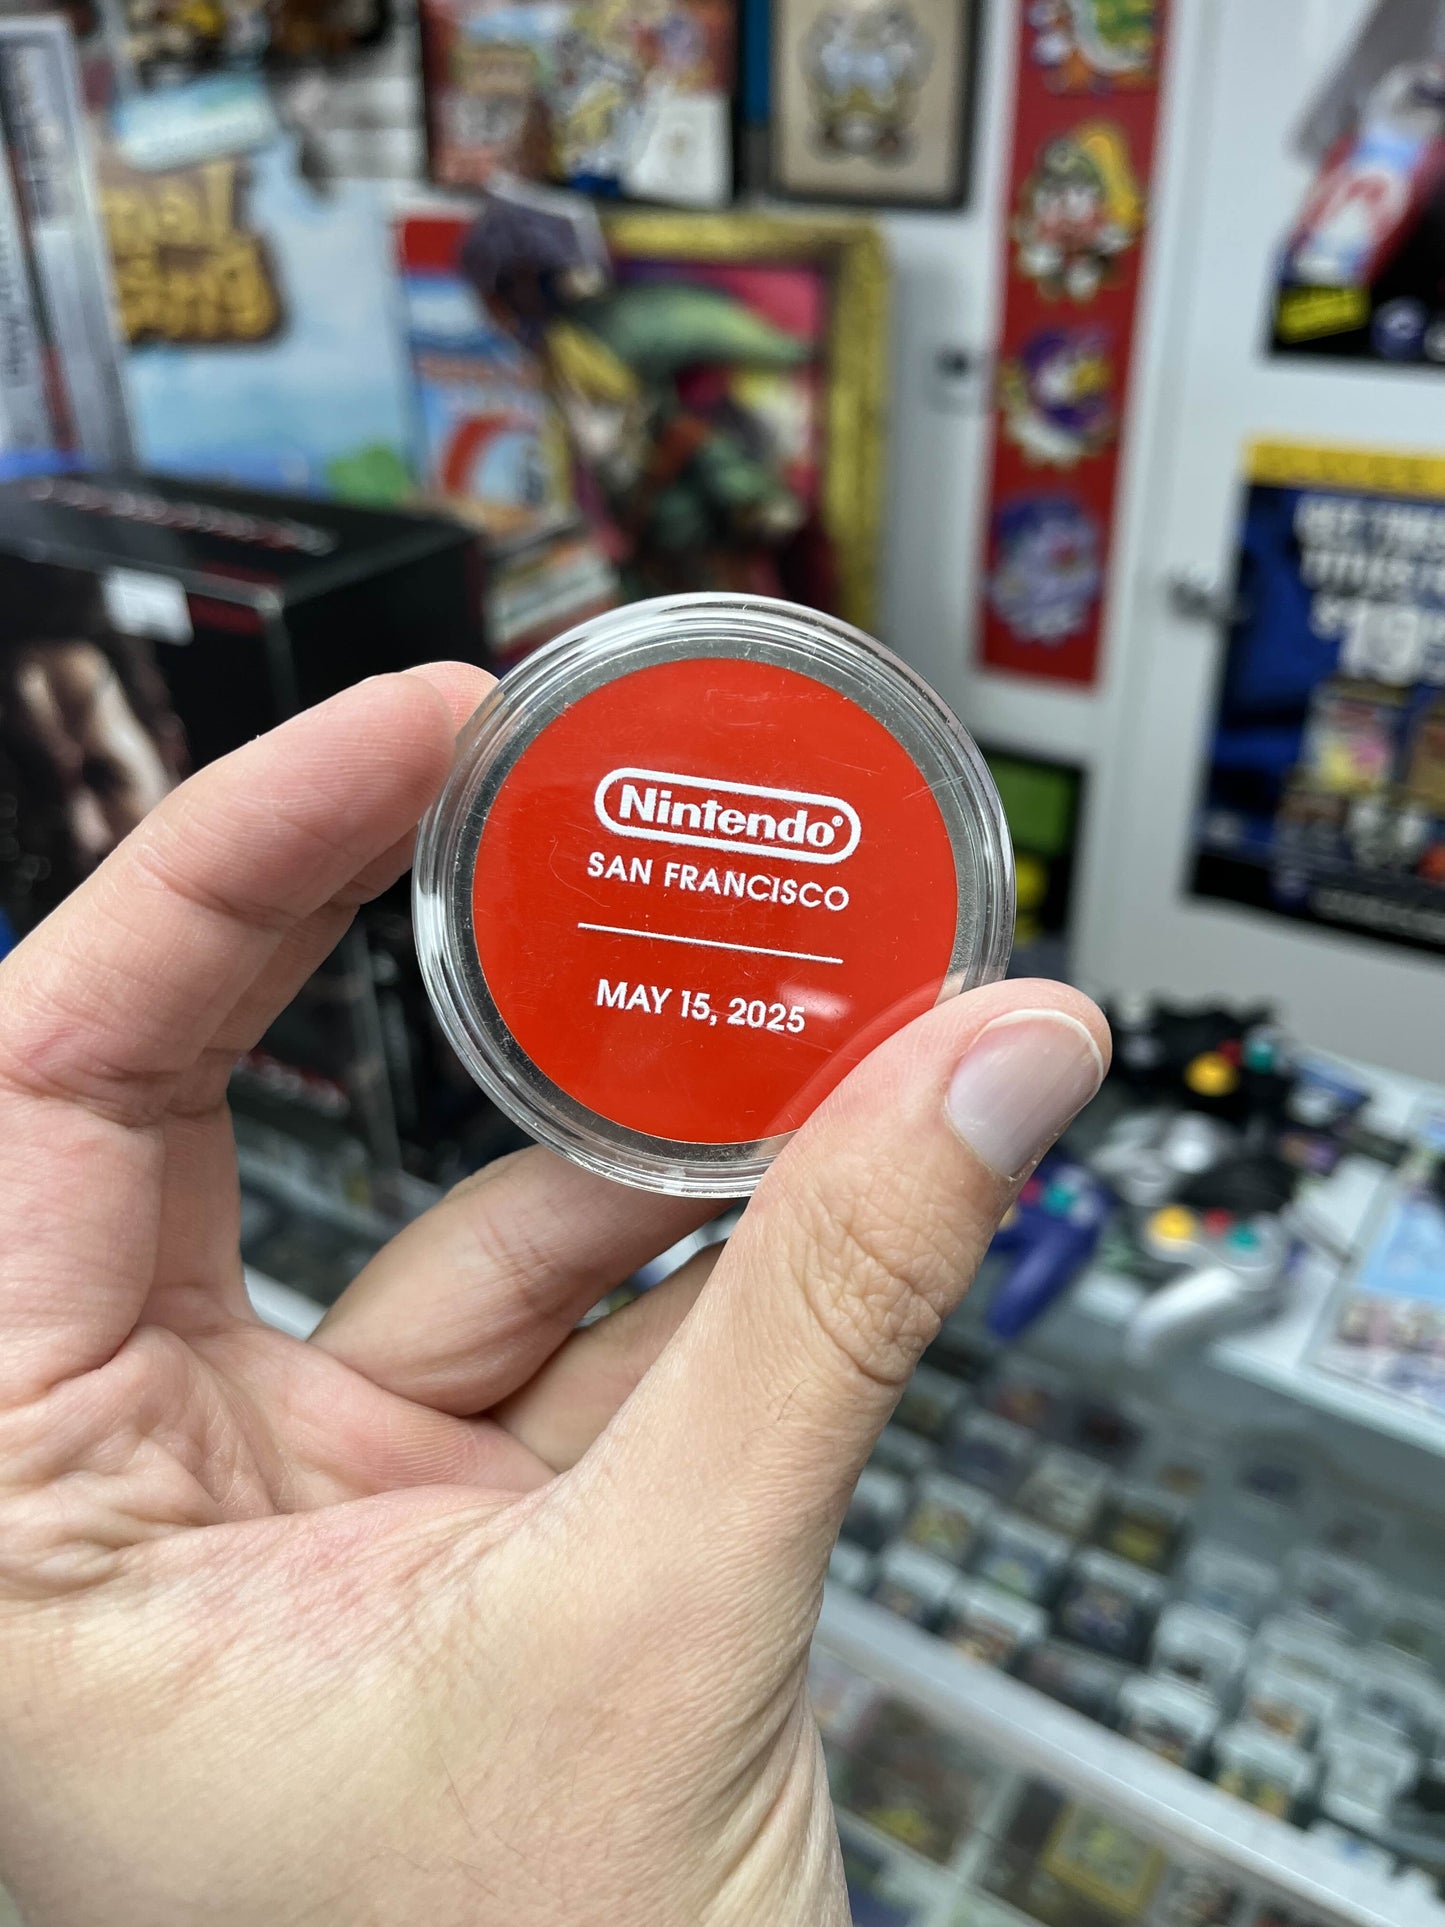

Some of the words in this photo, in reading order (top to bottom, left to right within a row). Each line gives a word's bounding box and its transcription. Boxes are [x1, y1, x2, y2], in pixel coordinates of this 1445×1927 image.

[587, 851, 653, 885] SAN
[664, 861, 850, 912] FRANCISCO
[597, 978, 672, 1014] MAY
[681, 989, 717, 1026] 15,
[727, 997, 807, 1034] 2025
